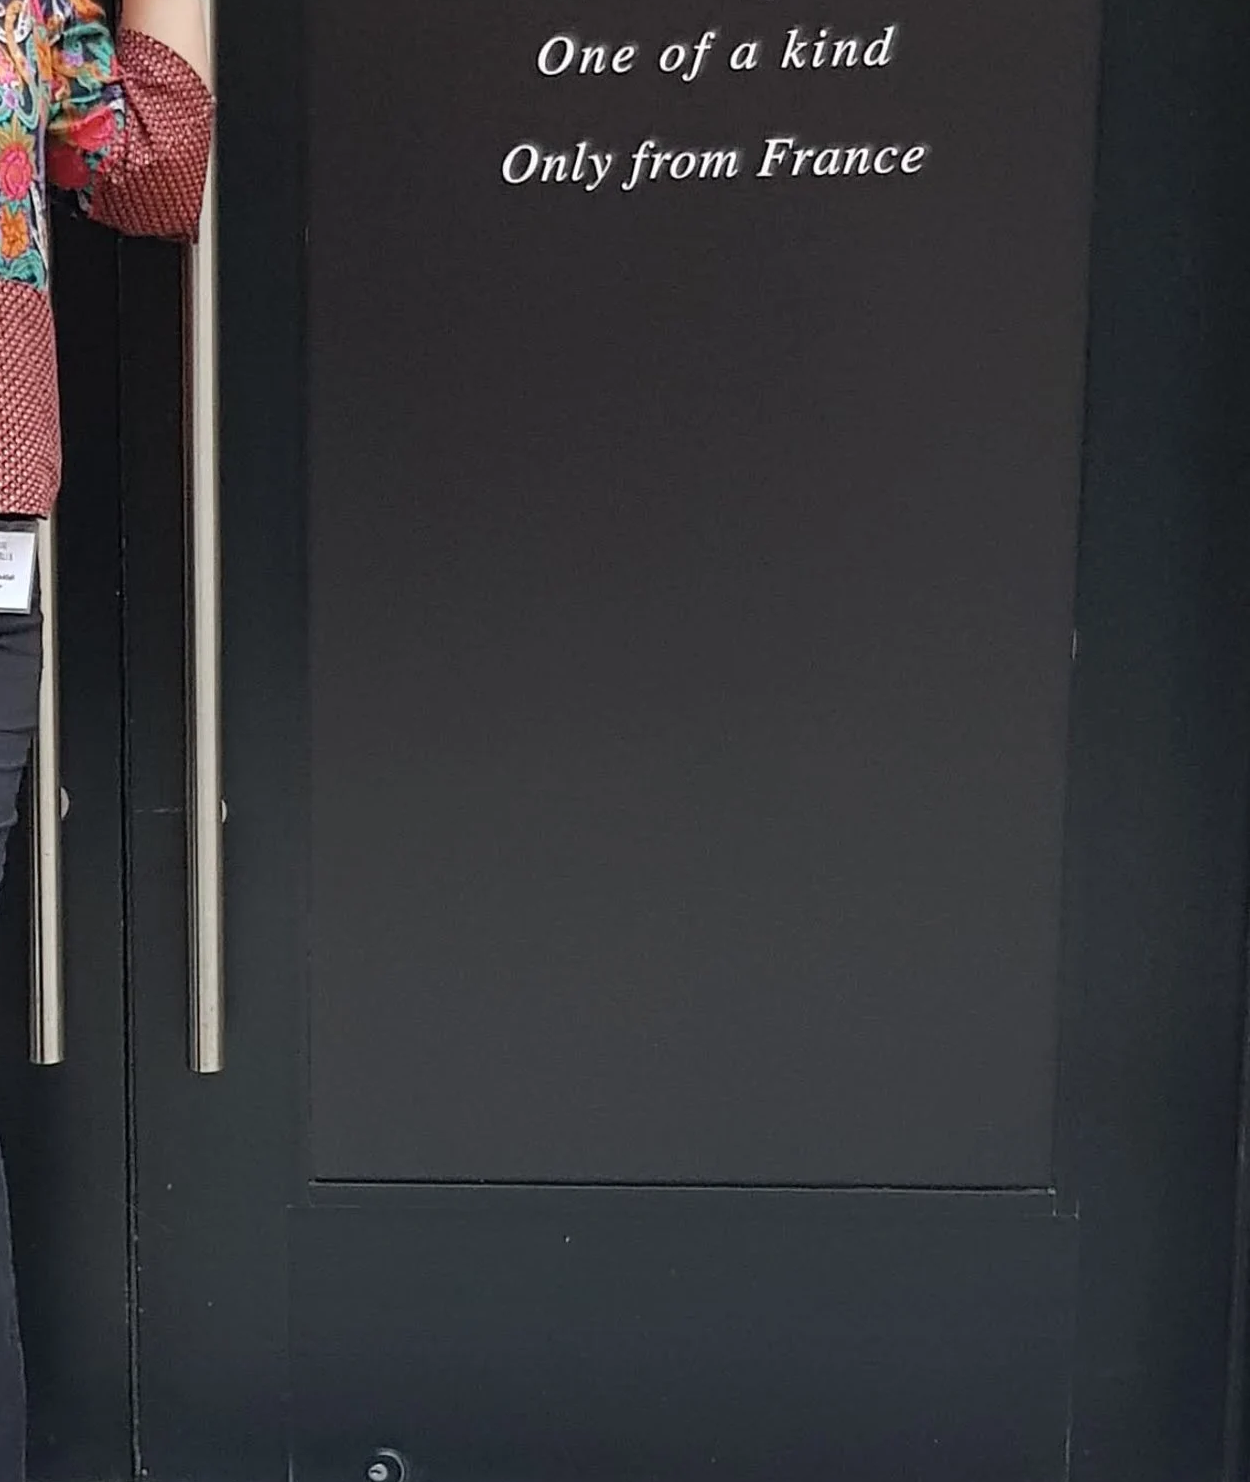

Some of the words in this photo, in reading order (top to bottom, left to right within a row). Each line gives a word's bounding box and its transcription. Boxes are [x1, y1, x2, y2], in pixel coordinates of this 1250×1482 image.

[537, 35, 638, 76] One
[659, 30, 717, 82] of
[729, 41, 759, 70] a
[781, 25, 896, 69] kind
[502, 140, 613, 192] Only
[621, 139, 739, 191] from
[755, 136, 927, 177] France
